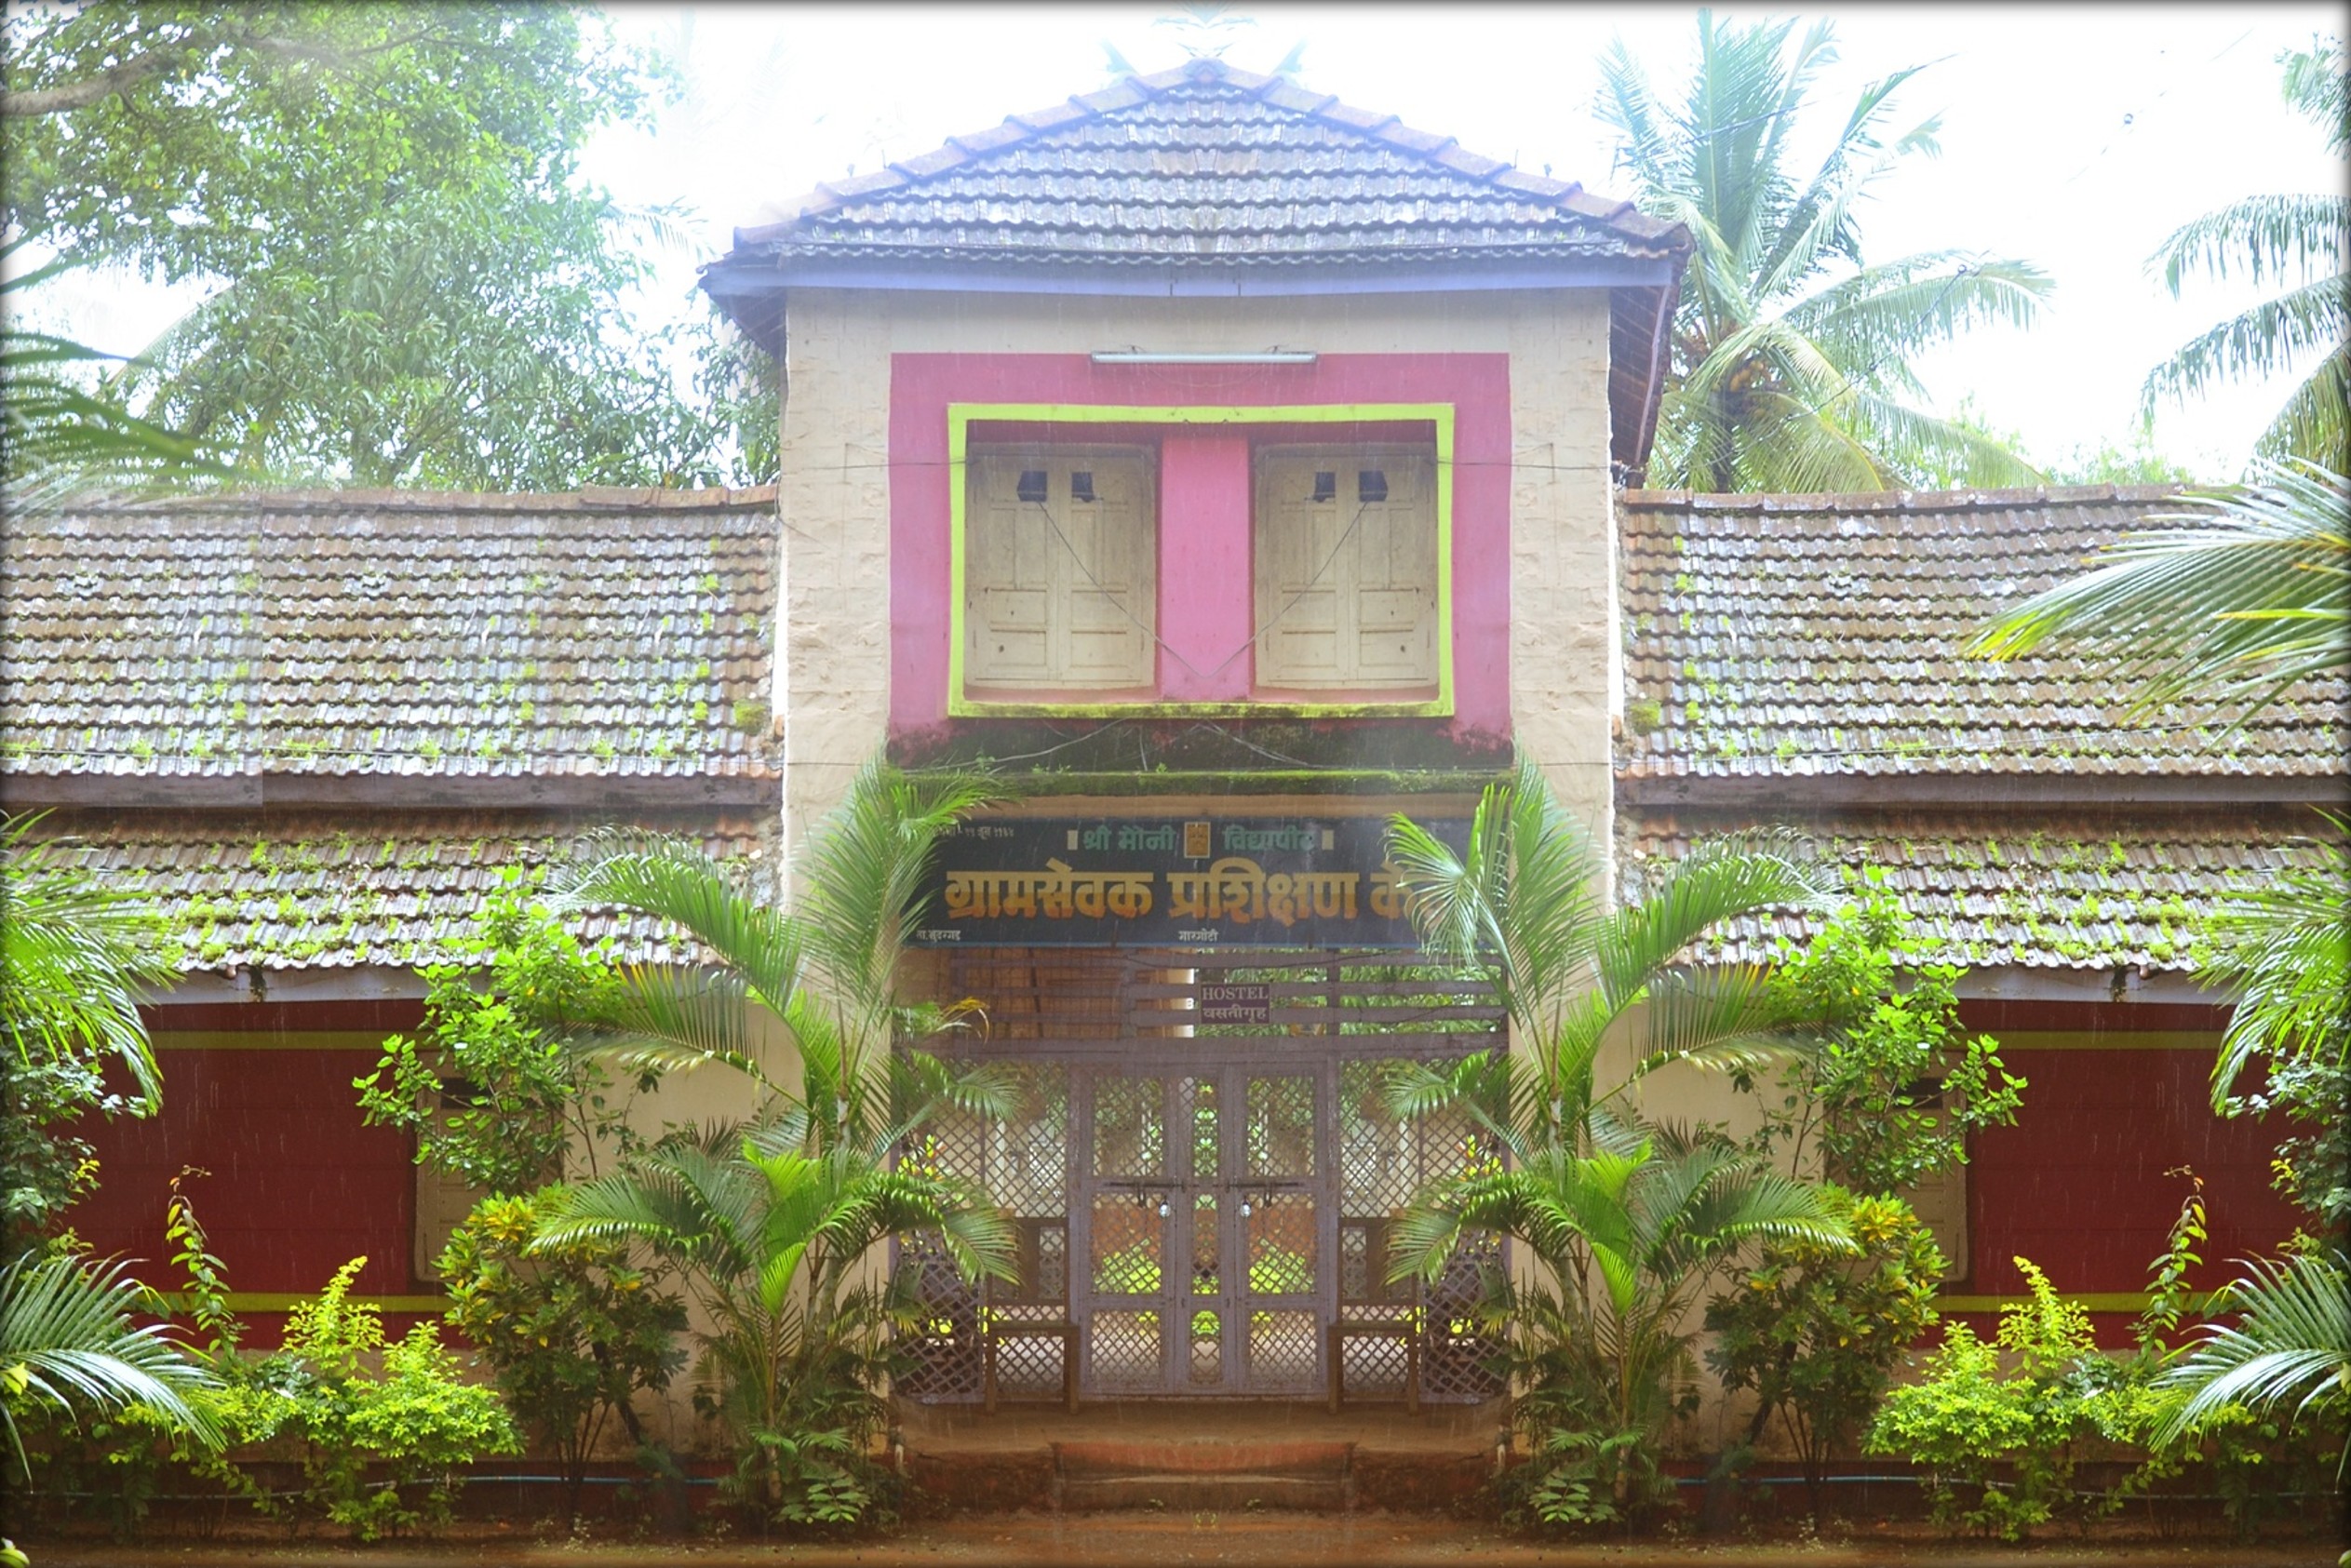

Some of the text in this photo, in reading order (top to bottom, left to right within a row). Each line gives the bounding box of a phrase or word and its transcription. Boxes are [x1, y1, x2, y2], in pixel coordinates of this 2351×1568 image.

[1082, 824, 1111, 851] श्री
[945, 857, 1153, 919] ग्रामसेवक
[1166, 856, 1360, 927] प्रशिक्षण
[1202, 986, 1268, 1000] HOSTEL
[1202, 1003, 1267, 1023] वसतीगृह
